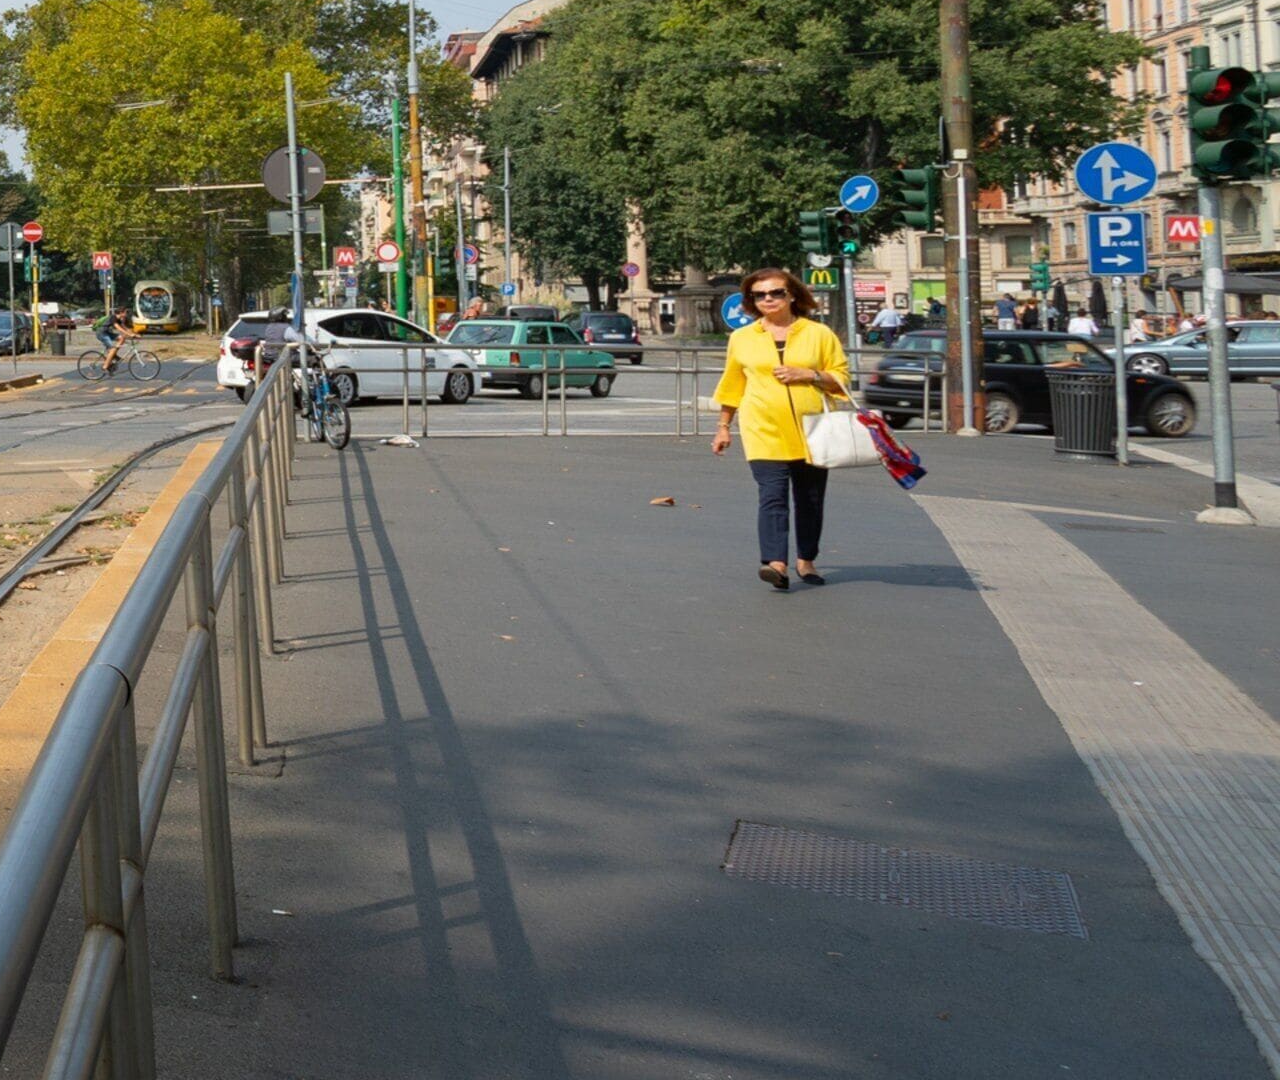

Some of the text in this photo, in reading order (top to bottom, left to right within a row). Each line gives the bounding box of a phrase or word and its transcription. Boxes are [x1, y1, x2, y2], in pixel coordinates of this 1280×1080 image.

[1099, 216, 1132, 247] P
[1169, 220, 1199, 237] M
[95, 255, 110, 266] M
[337, 251, 355, 262] M
[504, 285, 513, 294] P
